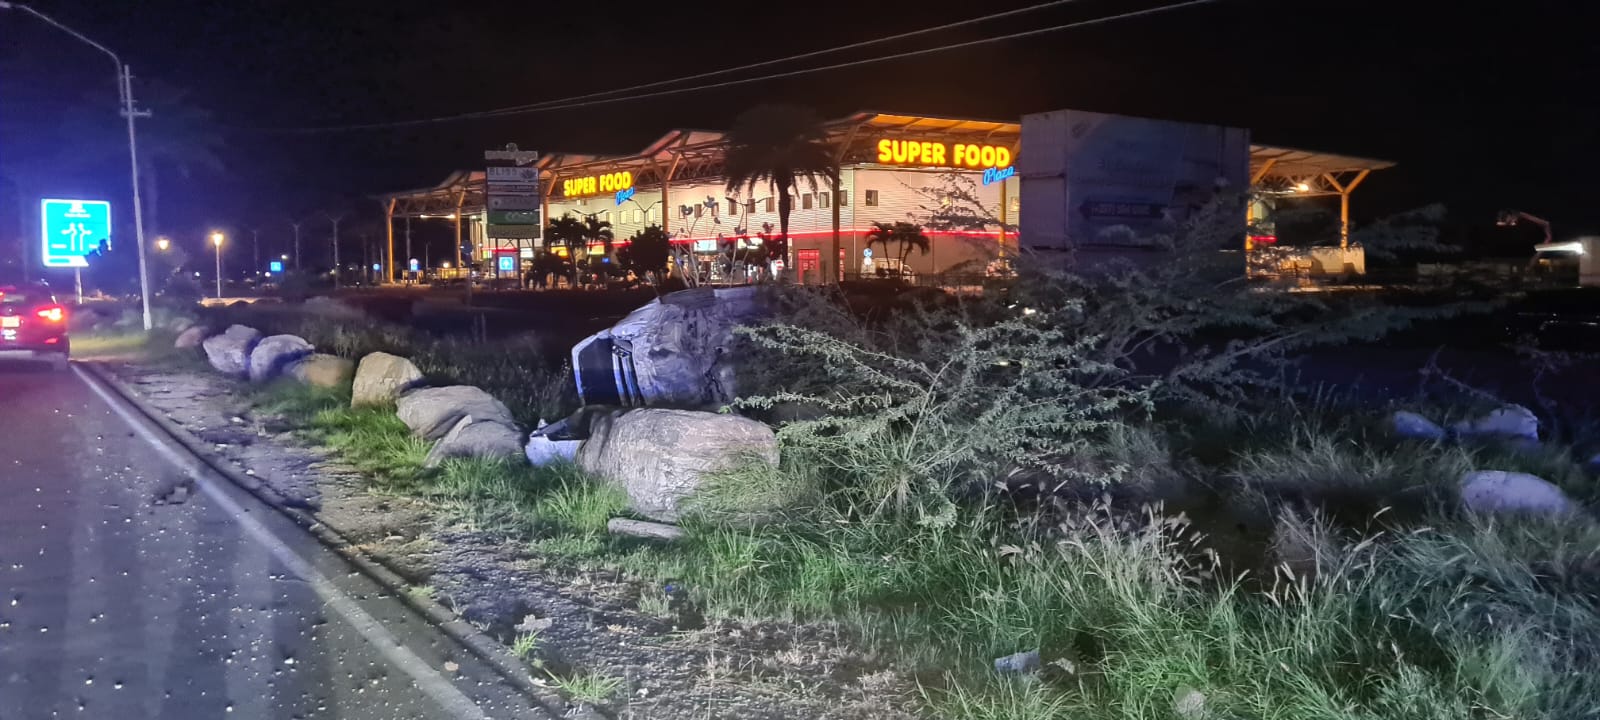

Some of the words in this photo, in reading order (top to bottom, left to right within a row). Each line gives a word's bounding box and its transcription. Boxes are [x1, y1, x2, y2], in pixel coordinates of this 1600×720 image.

[878, 139, 946, 164] SUPER
[954, 143, 1011, 168] FOOD
[564, 176, 596, 197] SUPER
[600, 172, 631, 192] FOOD
[982, 166, 1015, 186] Plaza
